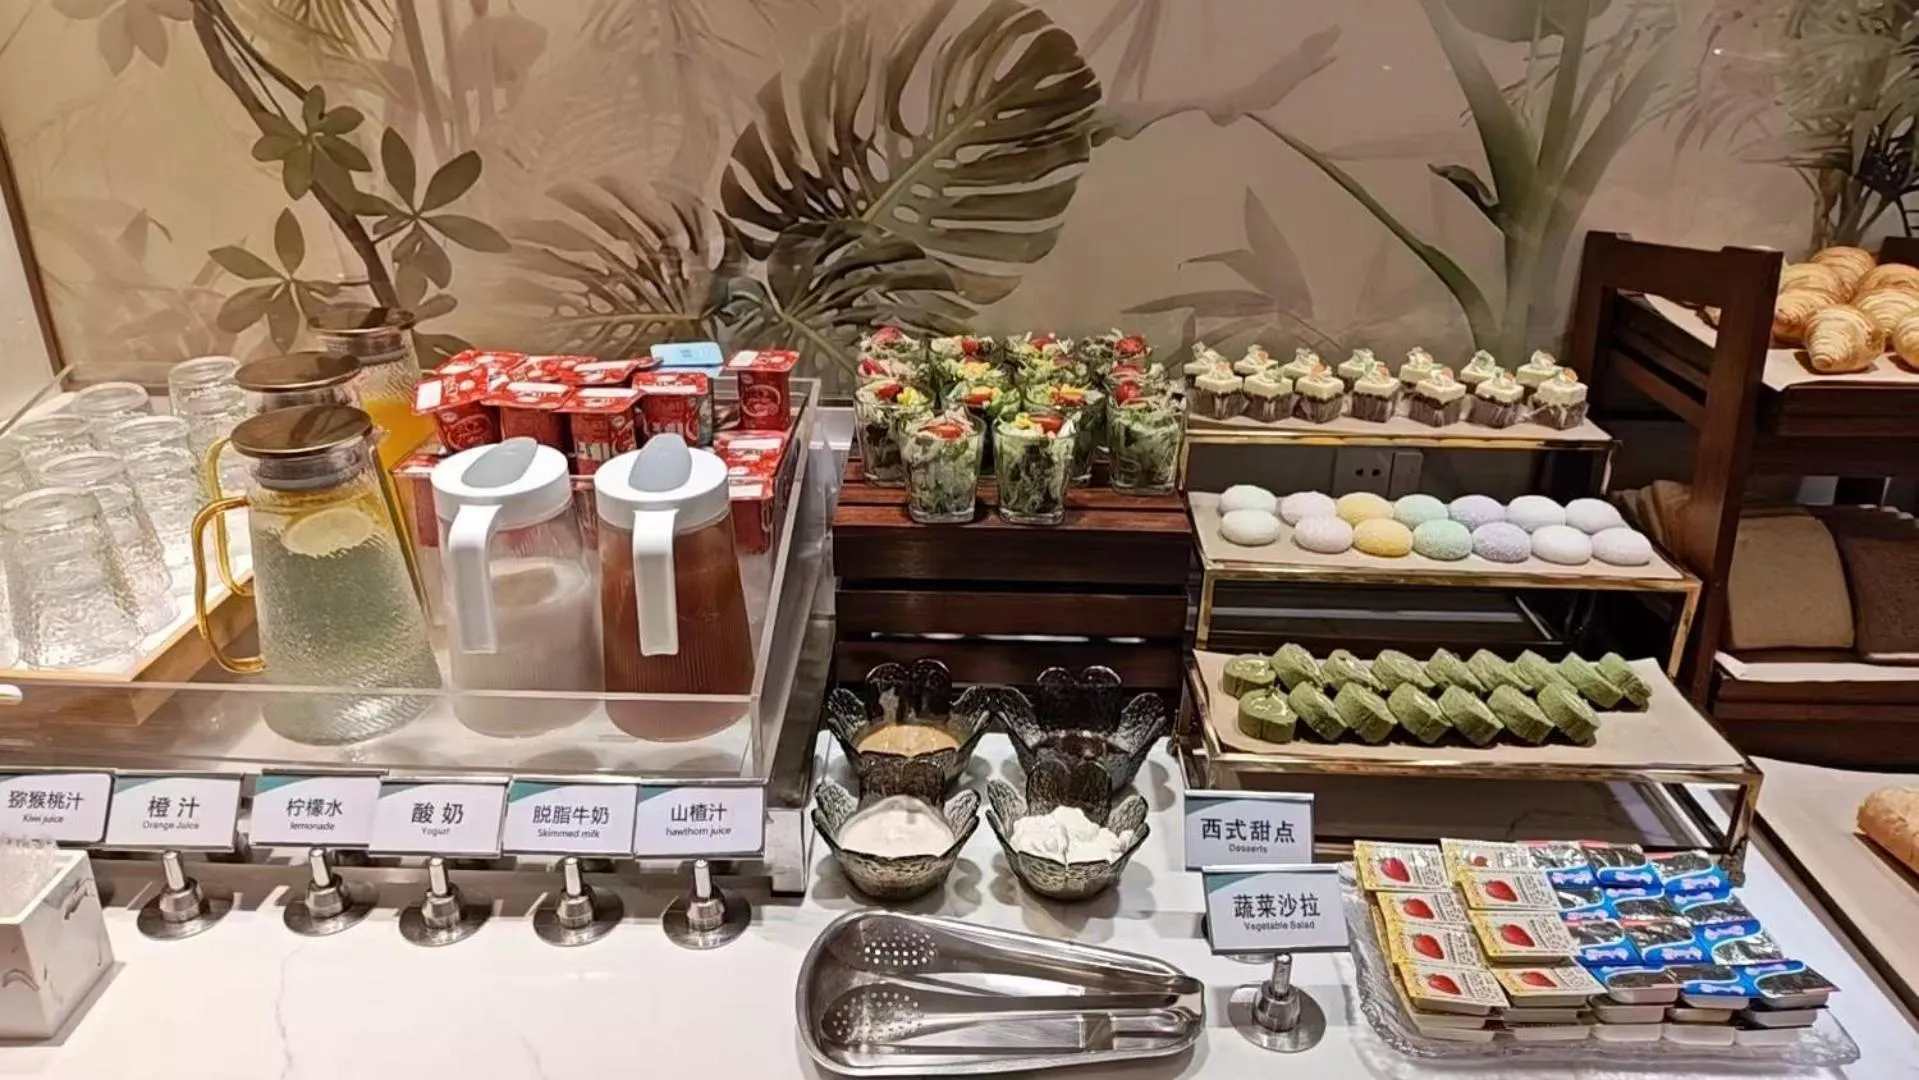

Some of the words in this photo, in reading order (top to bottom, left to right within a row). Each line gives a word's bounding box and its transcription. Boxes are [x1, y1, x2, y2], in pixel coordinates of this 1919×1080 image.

[7, 790, 85, 810] 猕猴桃汁
[286, 798, 343, 817] 柠檬水
[670, 802, 728, 822] 山楂汁
[532, 804, 610, 825] 脱脂牛奶
[142, 820, 174, 831] Orange
[176, 820, 200, 830] Juice
[290, 821, 335, 831] lemonade
[421, 826, 450, 837] Yogurt
[1200, 818, 1296, 844] 西式甜点
[537, 828, 580, 838] Skimmed
[581, 828, 601, 838] milk
[709, 826, 732, 838] juice
[1228, 843, 1268, 854] Desserts
[1232, 892, 1321, 919] 蔬菜沙拉
[1243, 920, 1289, 932] Vegetable
[1290, 920, 1315, 930] Salad
